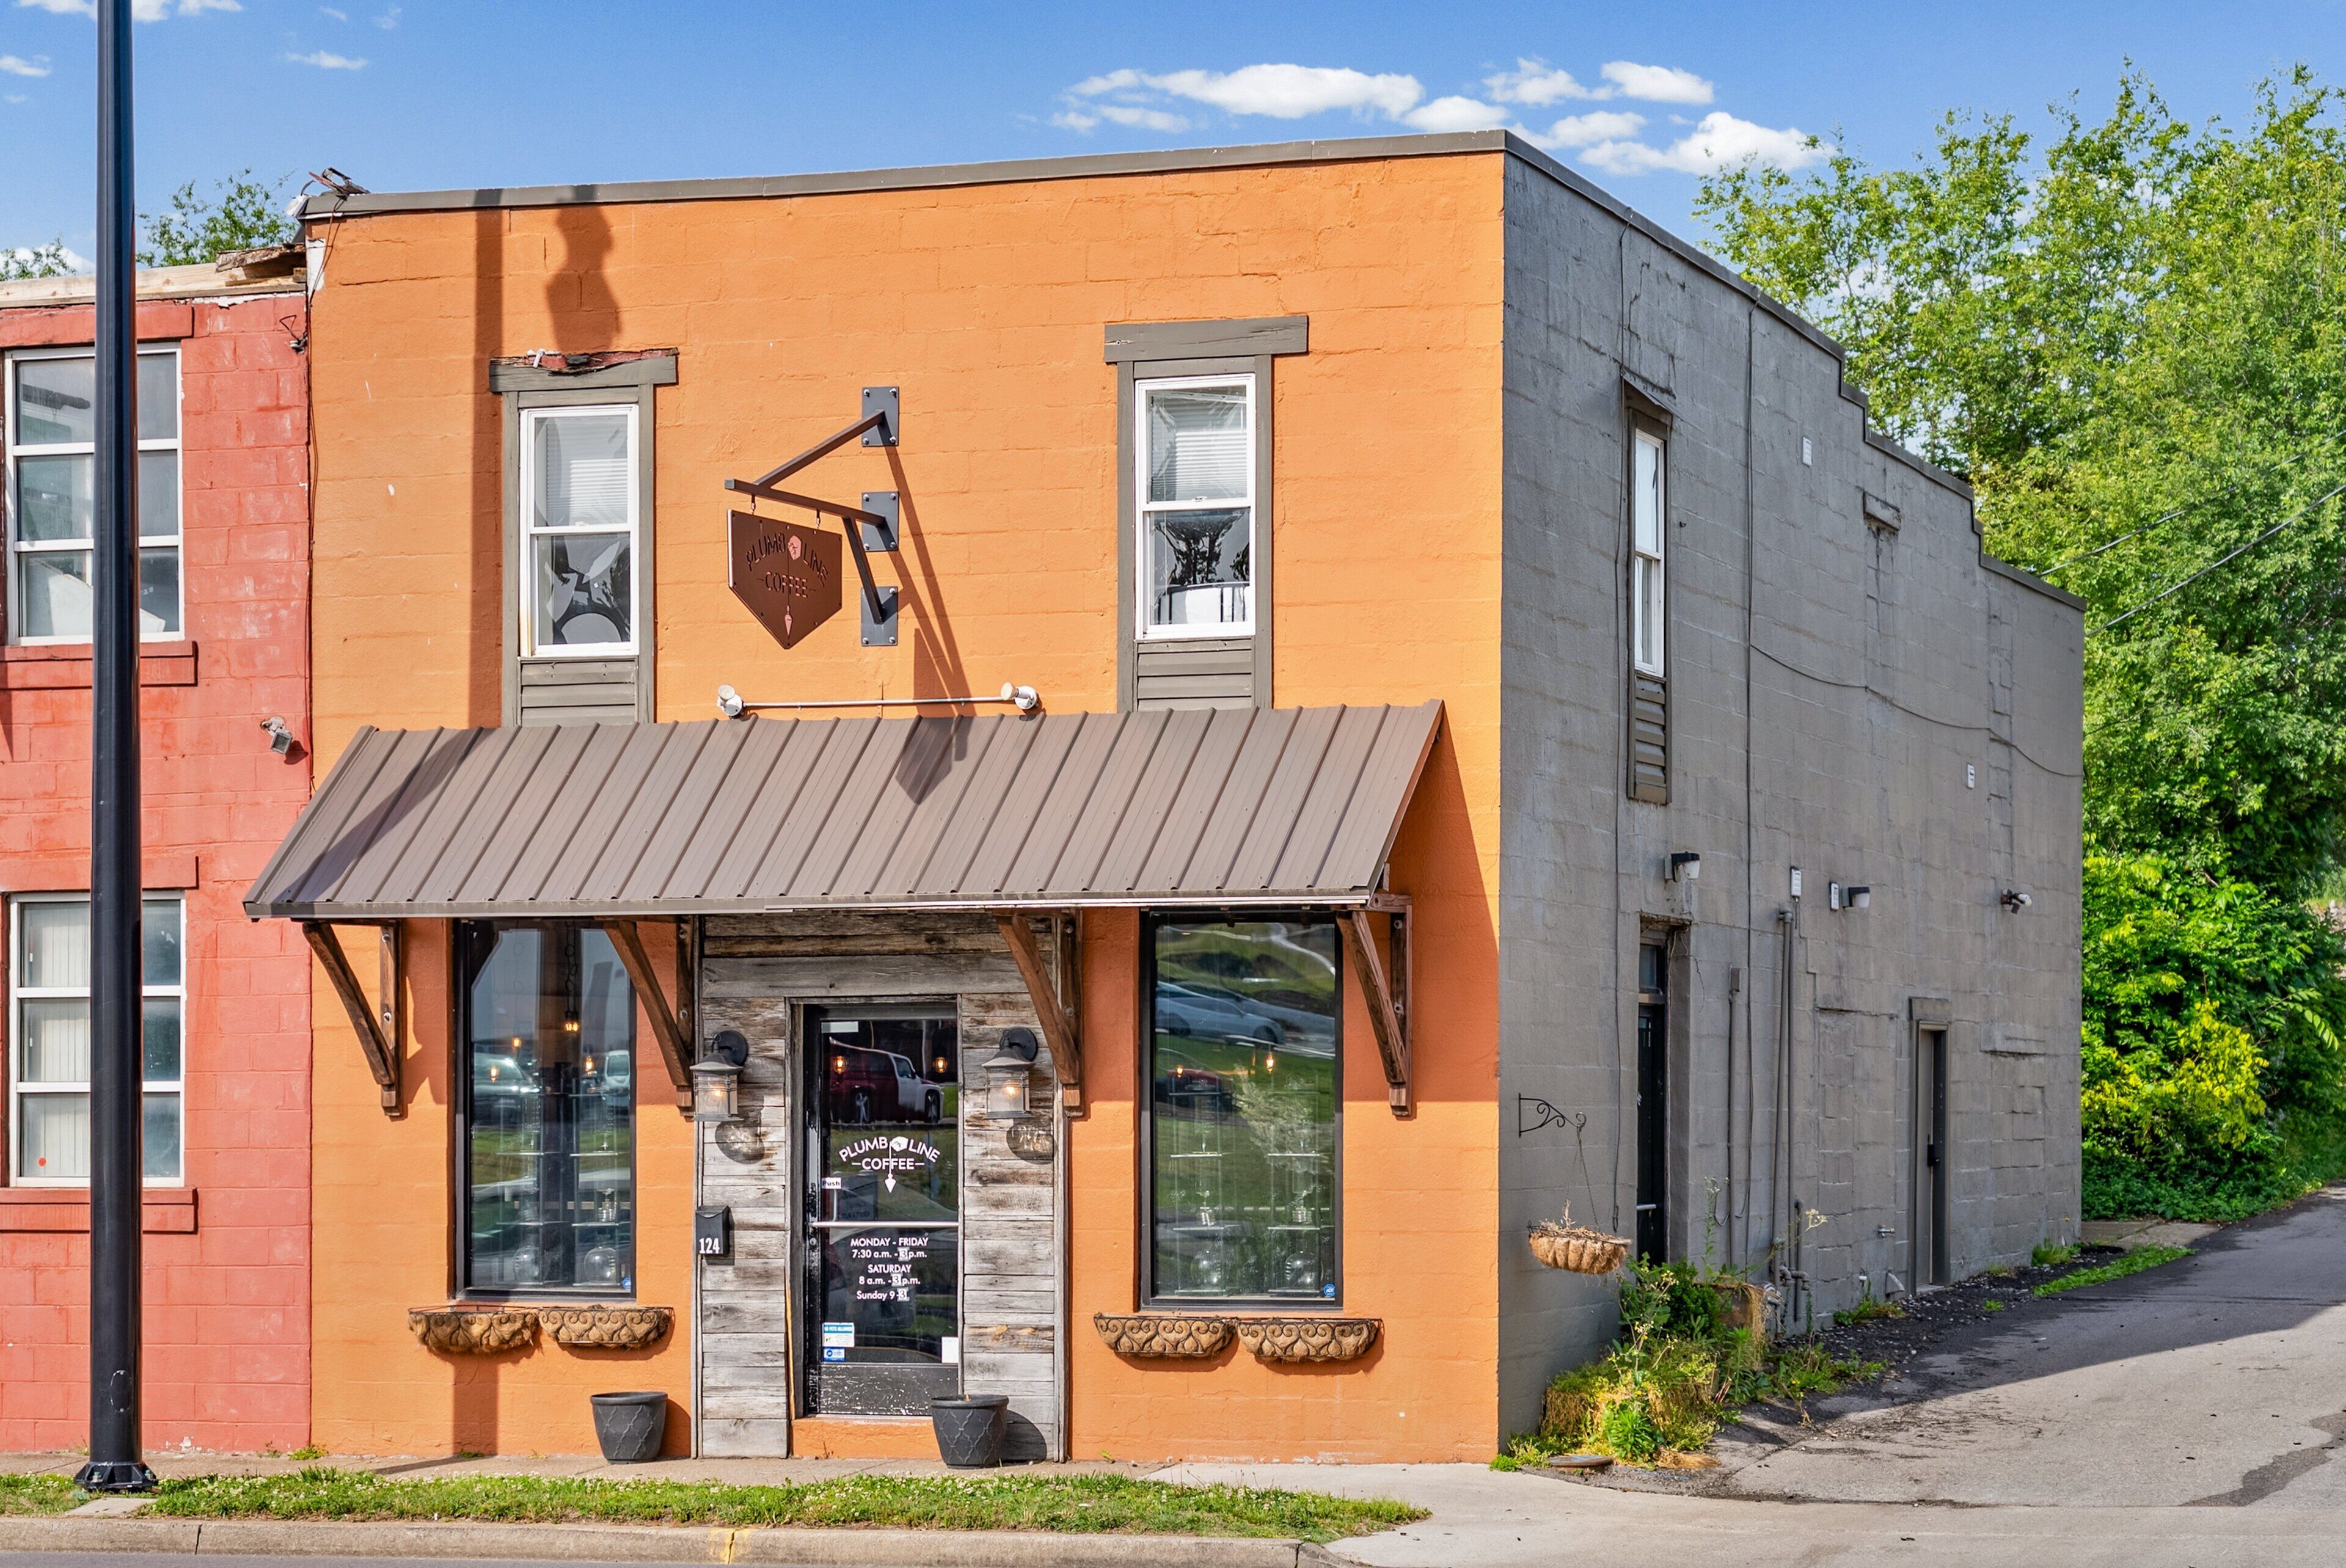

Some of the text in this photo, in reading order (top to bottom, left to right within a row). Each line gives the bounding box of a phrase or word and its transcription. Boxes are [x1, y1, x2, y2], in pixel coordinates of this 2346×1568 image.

[745, 533, 828, 588] PLUMB LINE
[765, 571, 808, 598] COFFEE
[839, 1136, 940, 1163] PLUMB LINE
[861, 1158, 915, 1170] COFFEE
[699, 1238, 720, 1254] 124
[850, 1238, 891, 1247] MONDAY
[899, 1238, 929, 1246] FRIDAY
[852, 1249, 872, 1258] 7:30
[868, 1264, 912, 1273] SATURDAY
[858, 1275, 865, 1285] 8
[902, 1277, 921, 1286] p.m.
[857, 1290, 887, 1301] Sunday
